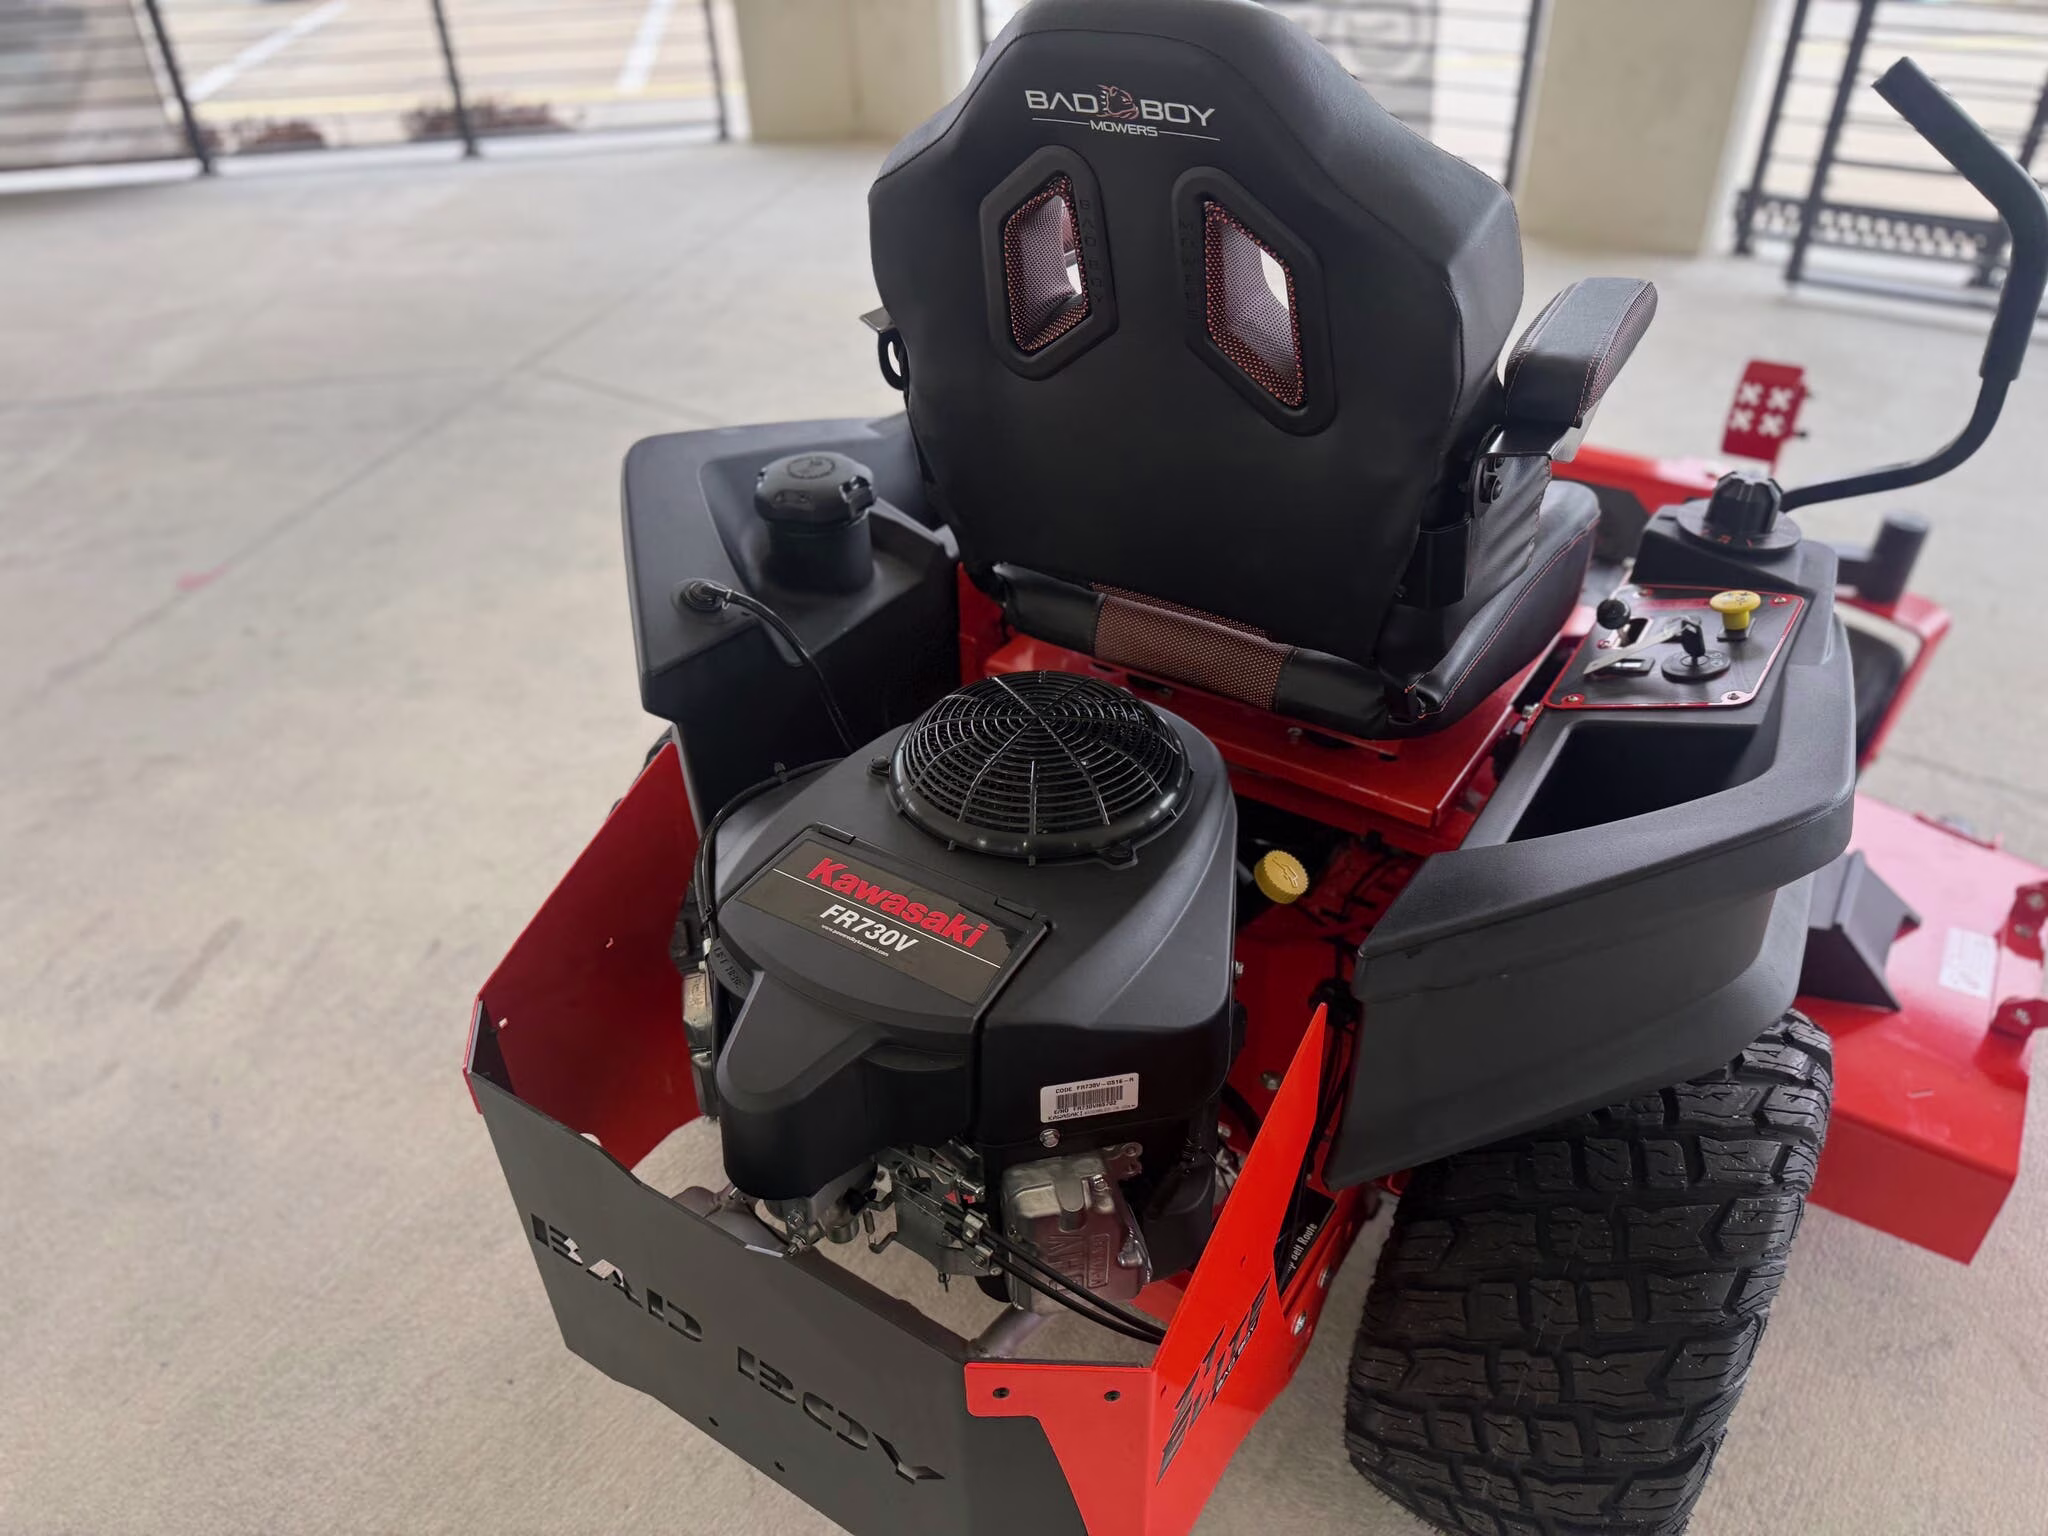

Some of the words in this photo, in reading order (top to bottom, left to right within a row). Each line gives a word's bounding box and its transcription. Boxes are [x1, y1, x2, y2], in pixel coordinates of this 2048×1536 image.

[1025, 90, 1099, 114] BAD
[1140, 99, 1216, 126] BOY
[1089, 119, 1158, 137] MOWERS
[806, 857, 990, 949] Kawasaki
[819, 904, 919, 953] FR730V
[1297, 1223, 1318, 1246] Route
[530, 1213, 703, 1342] BAD
[737, 1346, 945, 1485] BOY
